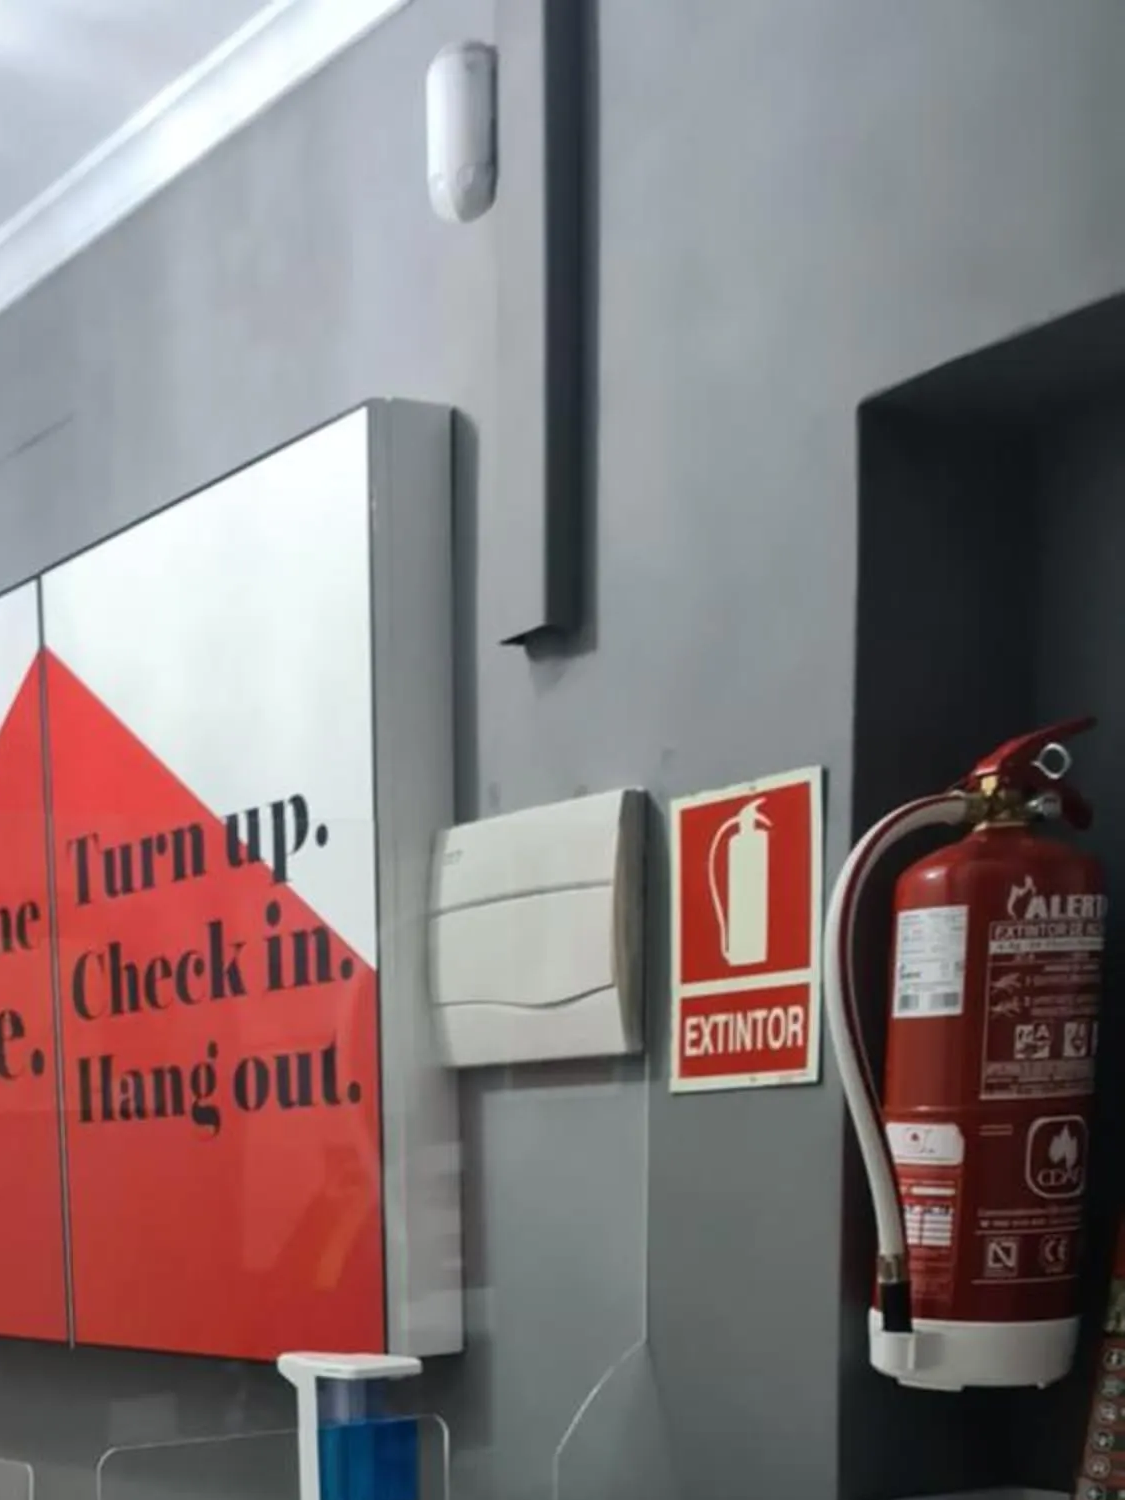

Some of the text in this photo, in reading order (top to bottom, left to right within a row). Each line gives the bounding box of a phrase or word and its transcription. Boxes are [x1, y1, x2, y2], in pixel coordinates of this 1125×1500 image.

[68, 793, 329, 906] Turn up.
[72, 901, 355, 1022] Check in.
[684, 1005, 804, 1057] EXTINTOR
[77, 1040, 362, 1141] Hang out.
